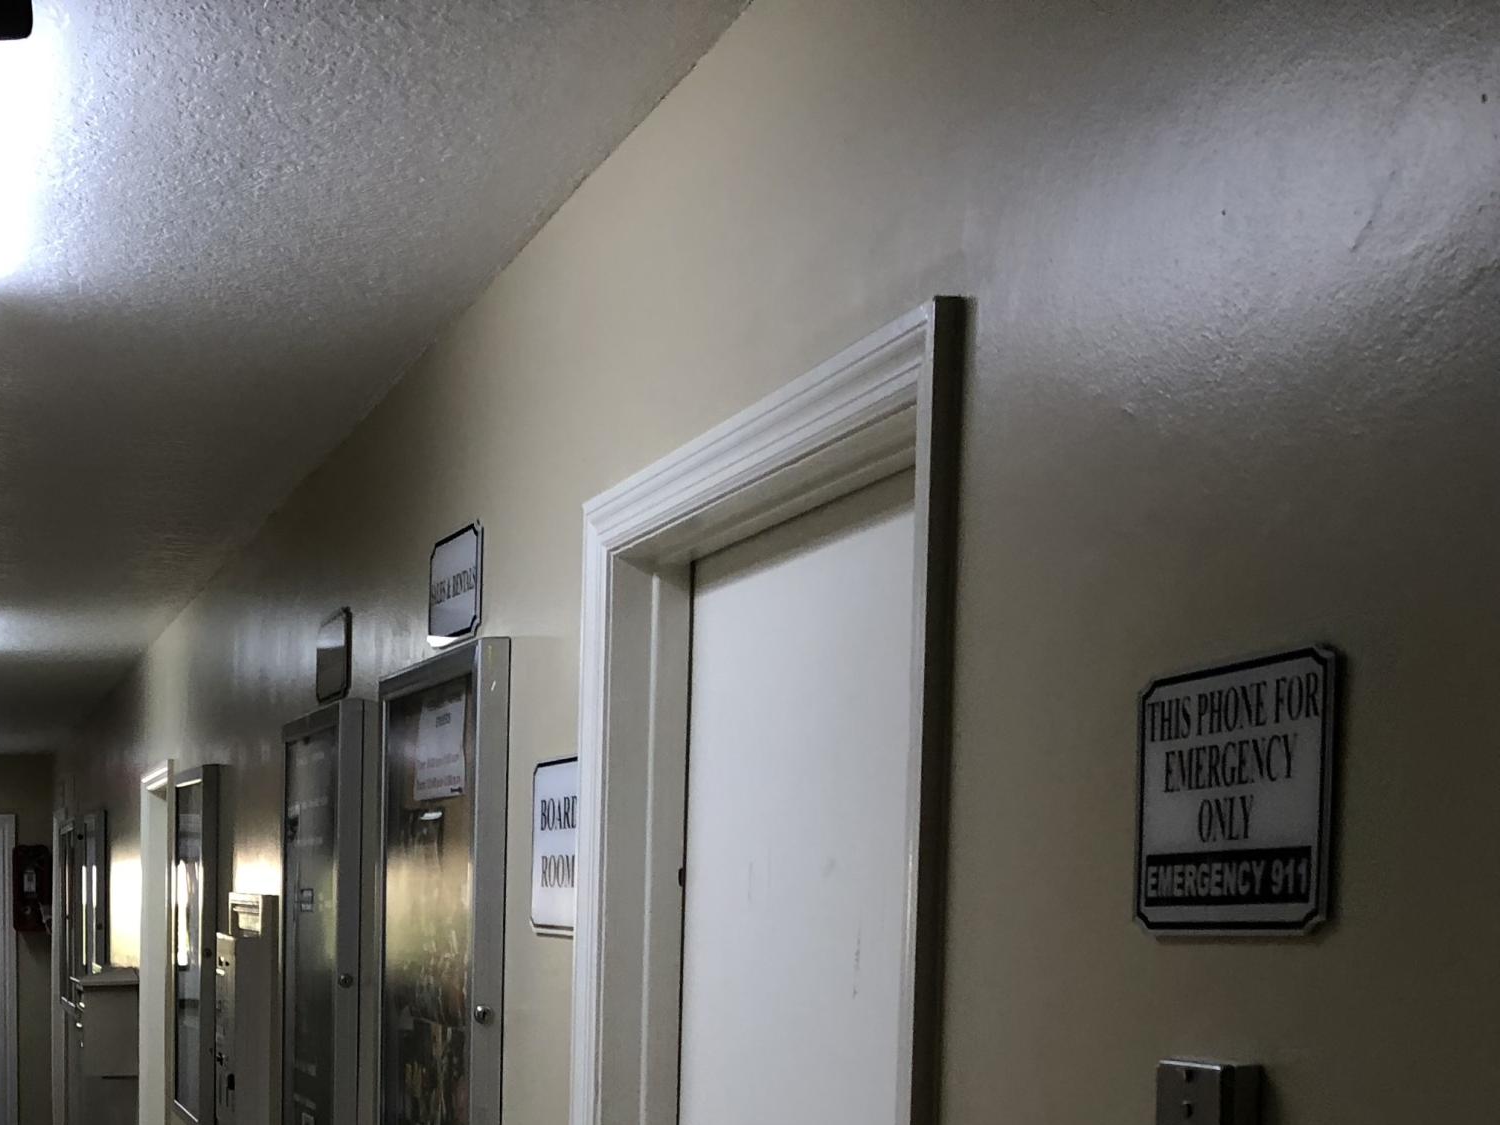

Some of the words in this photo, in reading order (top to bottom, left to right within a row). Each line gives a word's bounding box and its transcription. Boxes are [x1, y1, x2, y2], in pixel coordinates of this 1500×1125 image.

[1147, 696, 1191, 742] THIS
[1196, 681, 1268, 737] PHONE
[1274, 672, 1319, 724] FOR
[1164, 733, 1298, 793] EMERGENCY
[1198, 794, 1254, 843] ONLY
[541, 854, 576, 888] ROOM
[1146, 857, 1265, 898] EMERGENCY
[1270, 857, 1308, 896] 911
